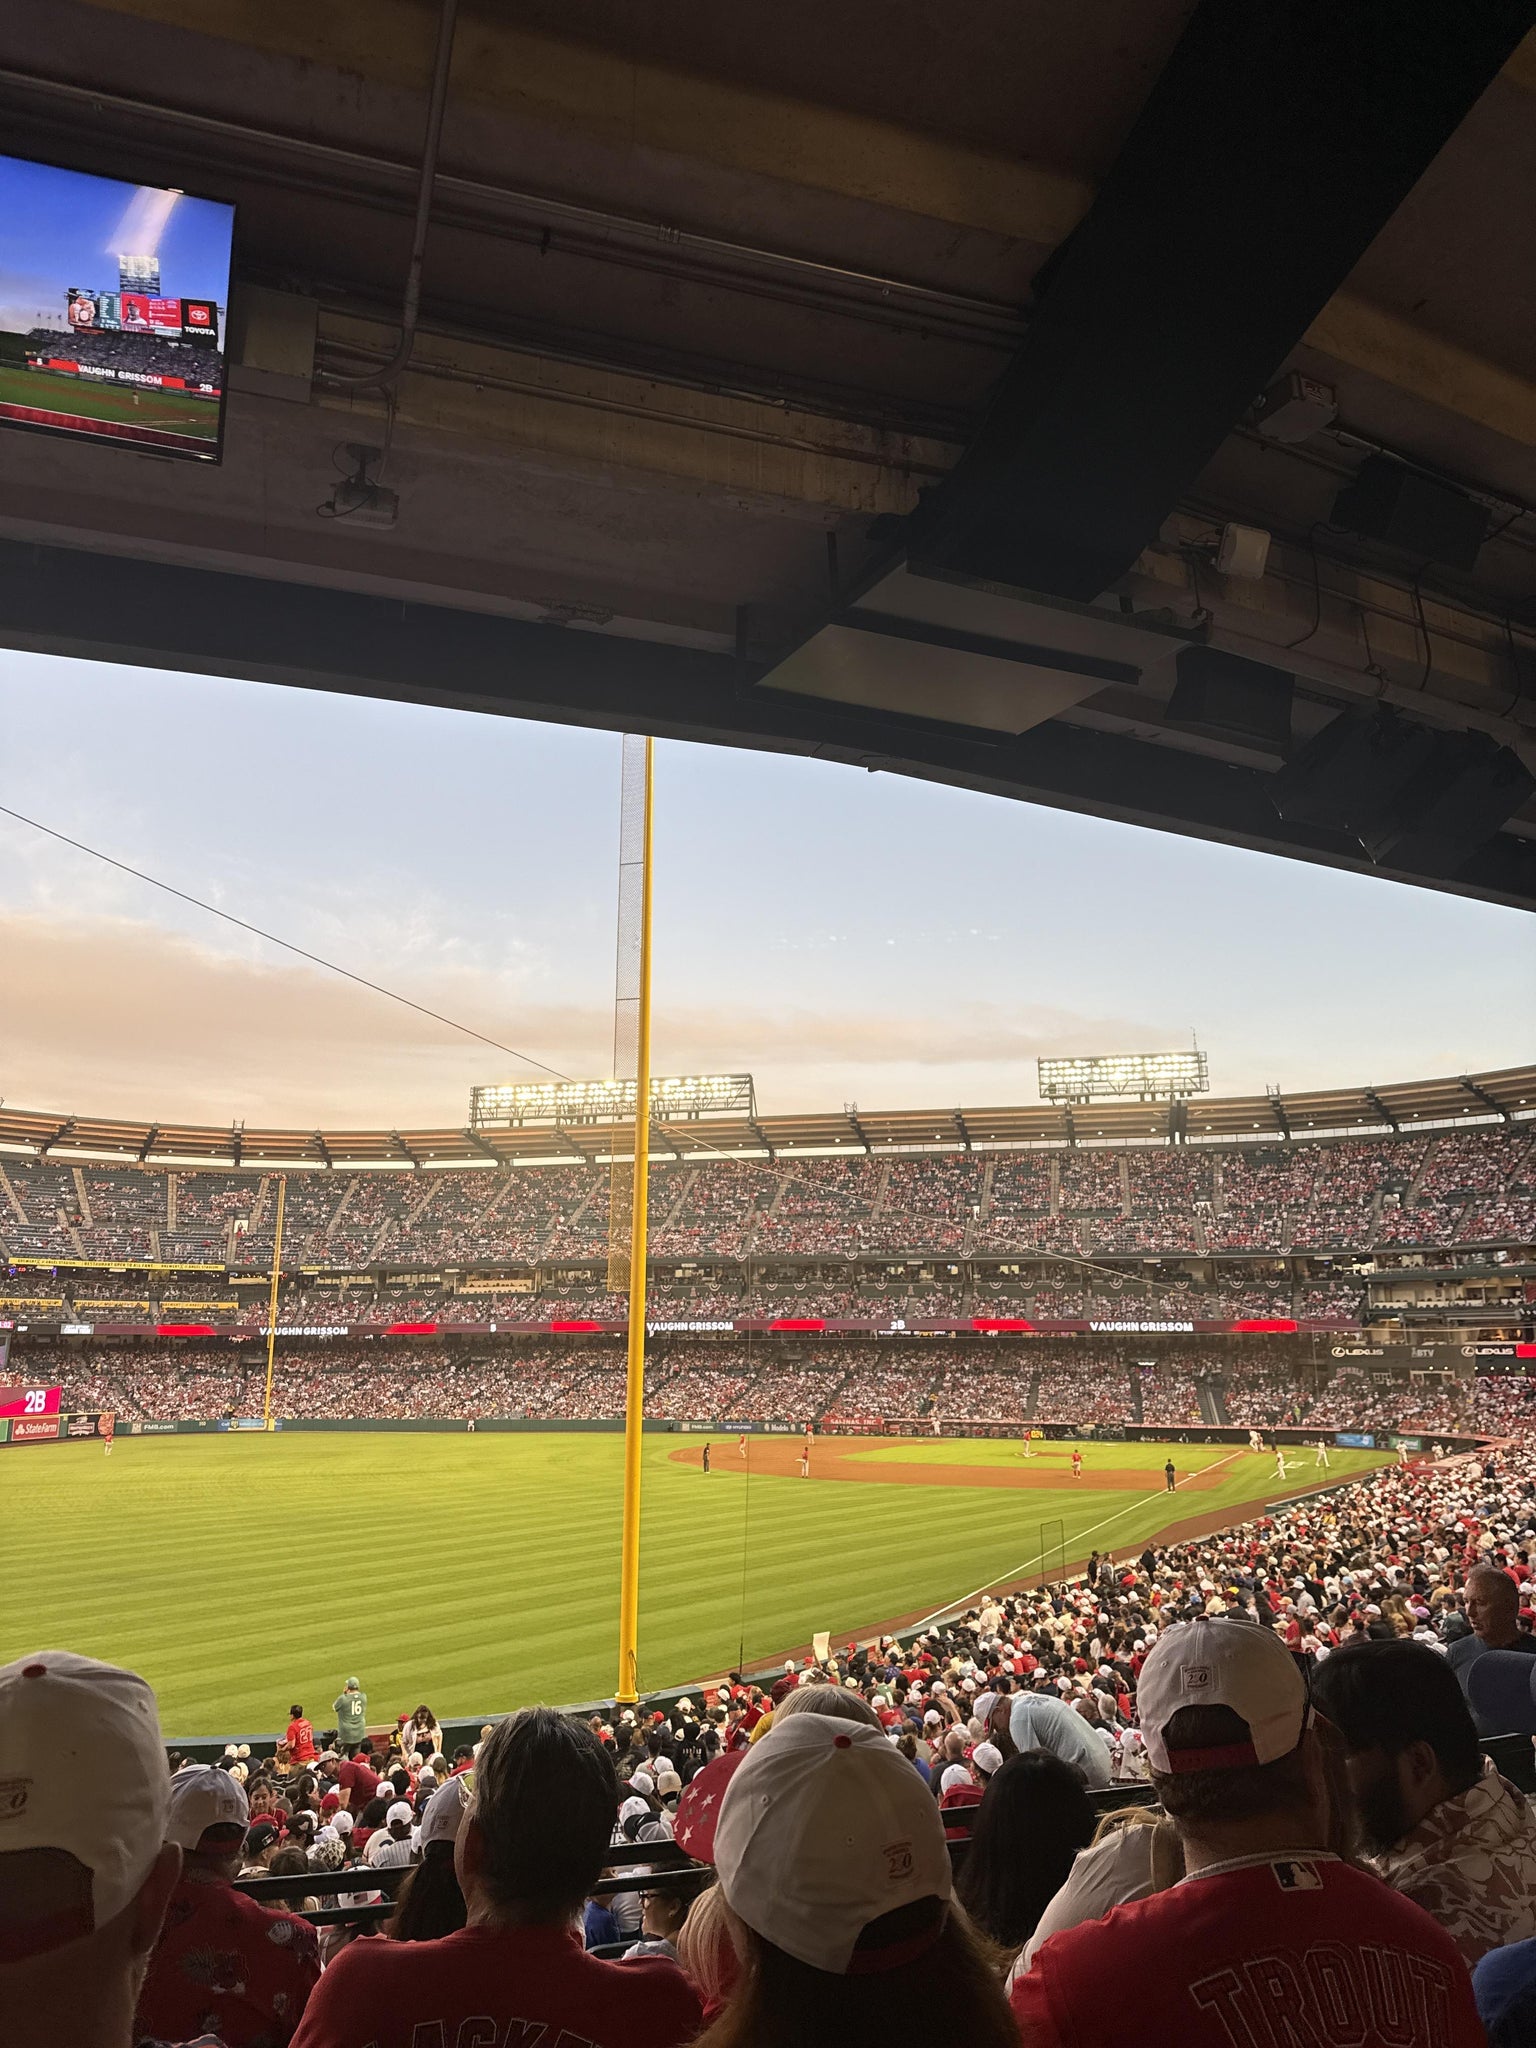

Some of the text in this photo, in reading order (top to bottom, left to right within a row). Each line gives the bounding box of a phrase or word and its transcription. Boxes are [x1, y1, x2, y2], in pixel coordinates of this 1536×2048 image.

[184, 326, 215, 336] TOYOTA
[78, 364, 115, 378] VAUGHN
[118, 371, 163, 385] GRISSOM
[200, 383, 213, 393] 2B
[647, 1321, 734, 1331] VAUGHN GRISSOM
[890, 1320, 905, 1330] 2B
[1089, 1321, 1194, 1332] VAUGHN GRISSOM
[303, 1327, 348, 1335] GRISSOM
[1345, 1348, 1384, 1356] LEXUS
[1475, 1347, 1514, 1356] LEXUS
[24, 1390, 46, 1413] 2B
[351, 1700, 362, 1715] 16
[1188, 1937, 1456, 2048] TROUT
